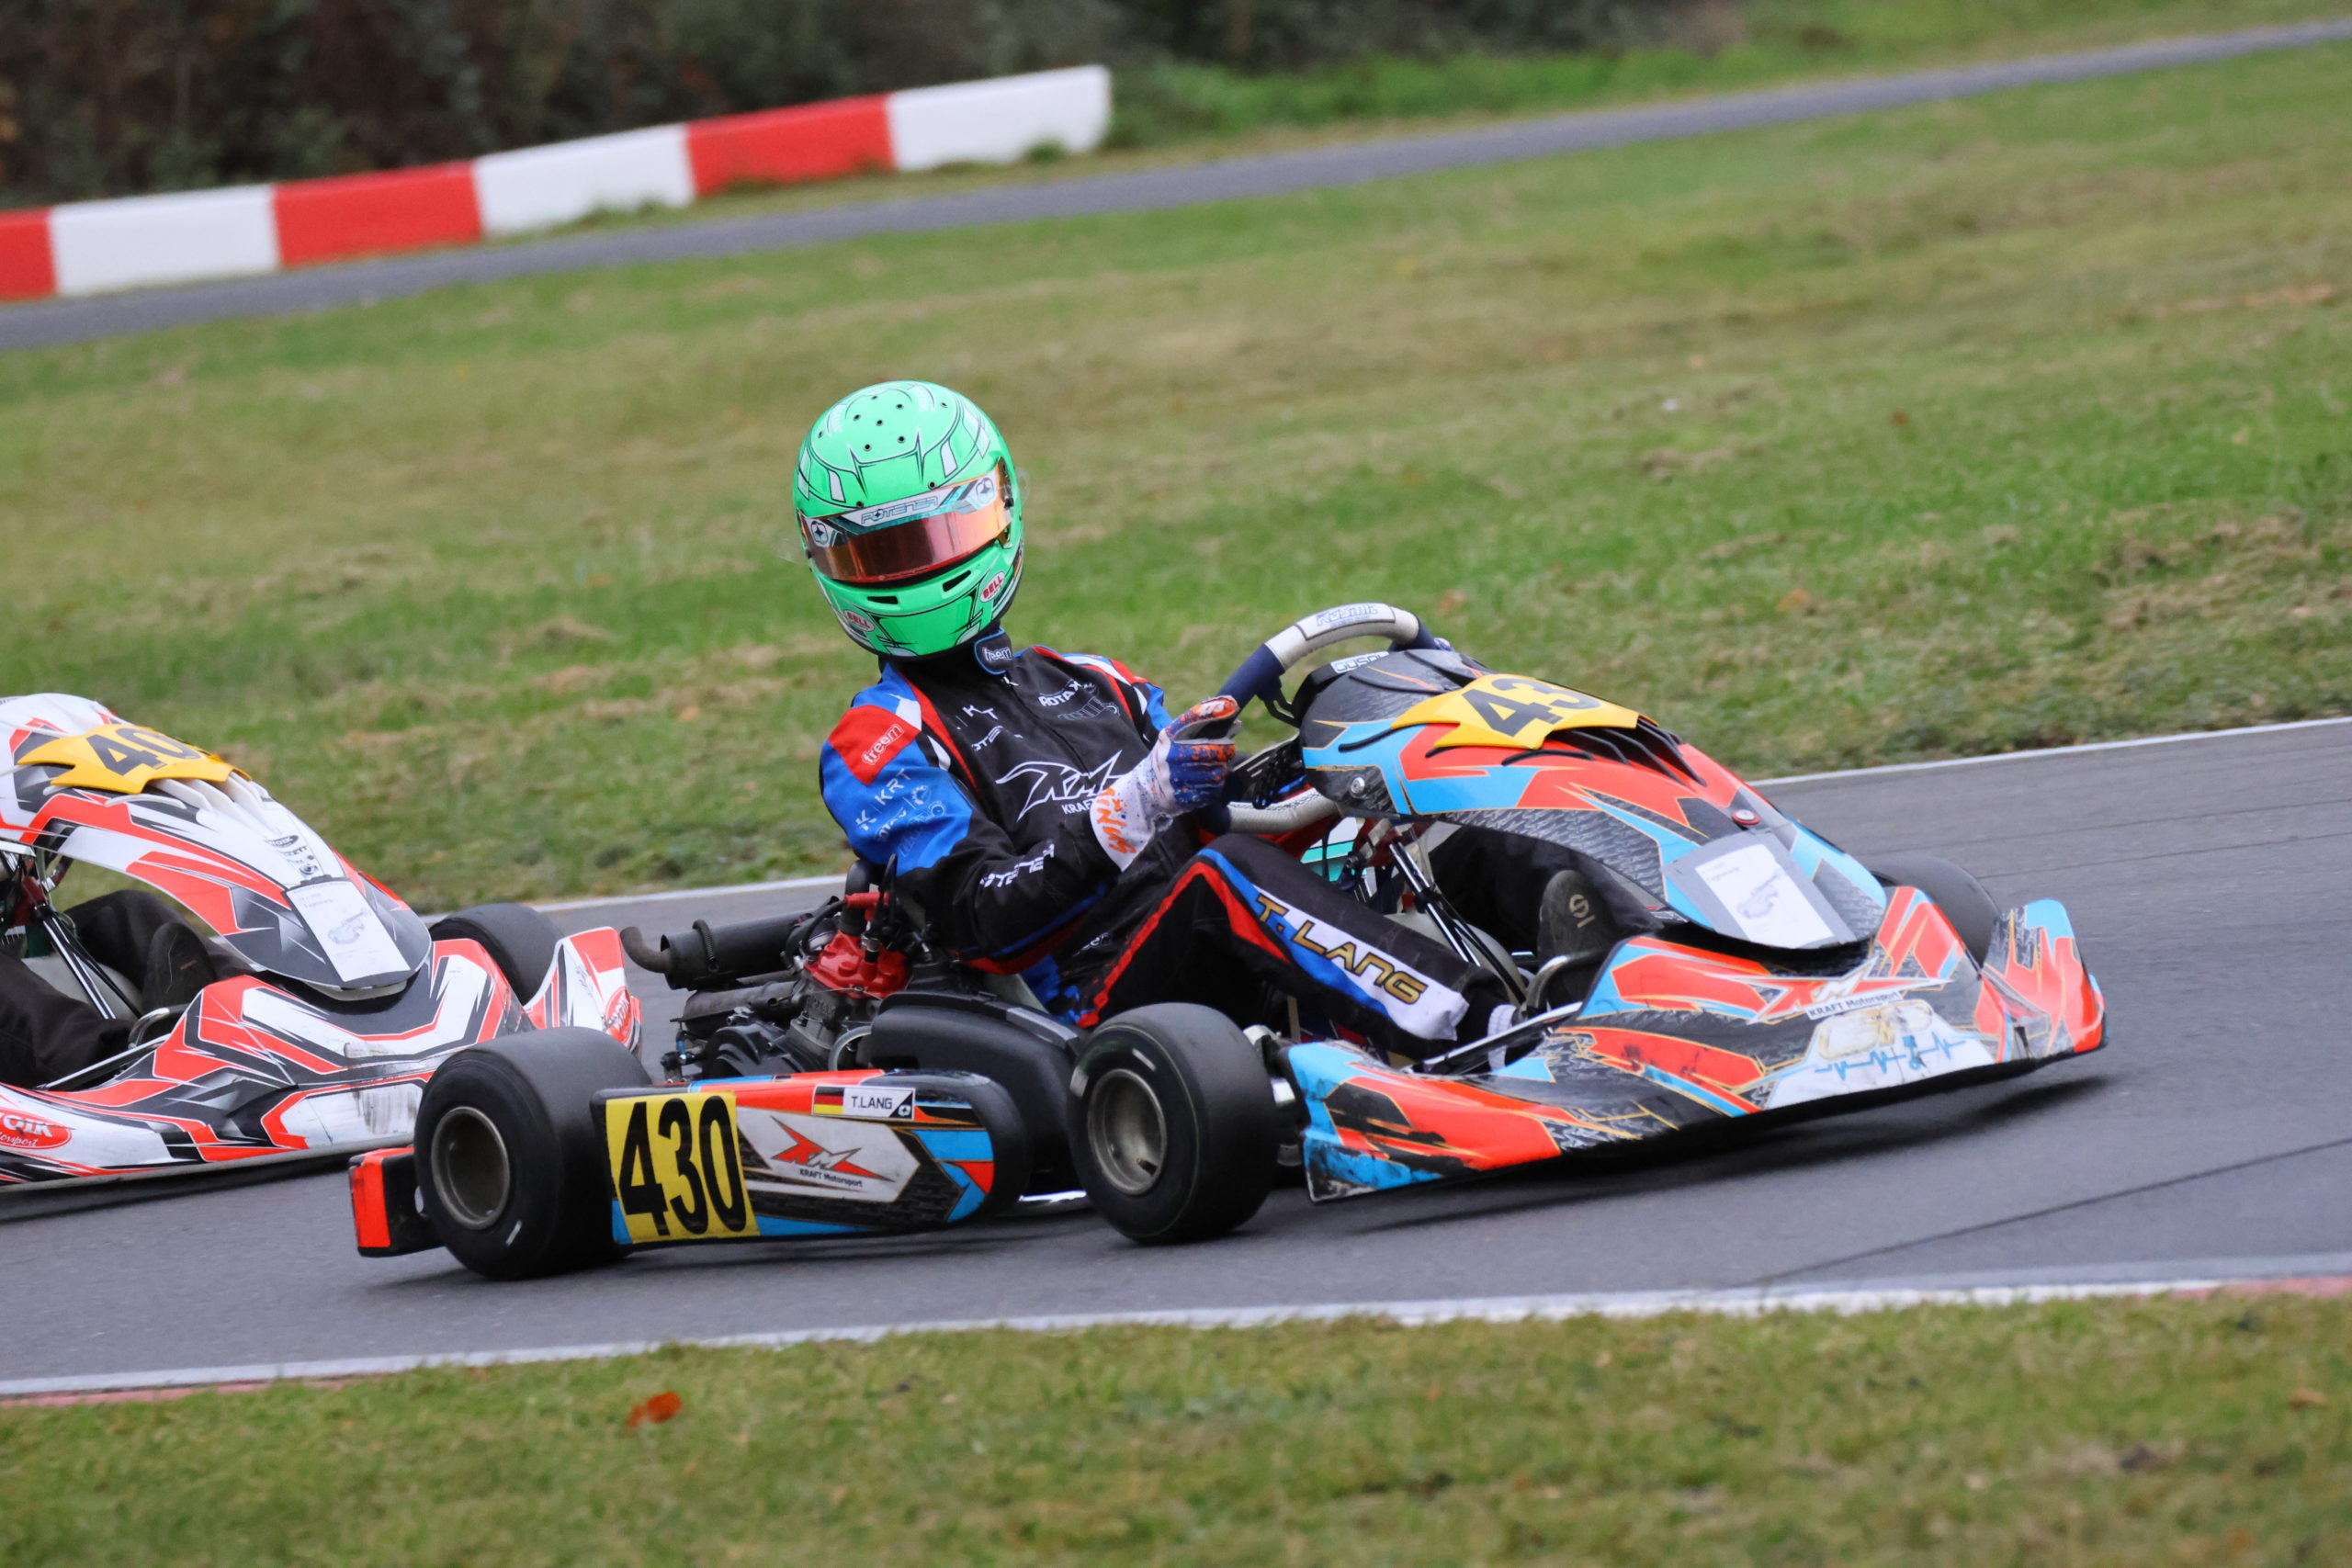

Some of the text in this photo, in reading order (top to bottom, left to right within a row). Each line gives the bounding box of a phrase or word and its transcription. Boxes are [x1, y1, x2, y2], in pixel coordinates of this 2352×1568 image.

[982, 576, 1004, 599] BELL
[846, 611, 871, 629] BELL
[982, 647, 1012, 663] freem
[1038, 680, 1082, 706] ROTAX
[862, 724, 904, 764] freem
[875, 768, 912, 806] KRT
[1256, 893, 1429, 1005] T. LANG
[1809, 991, 1900, 1017] KRAFT Motorsport
[851, 1096, 893, 1110] T.LANG
[618, 1095, 747, 1236] 430
[799, 1168, 864, 1188] KRAFT Motorsport
